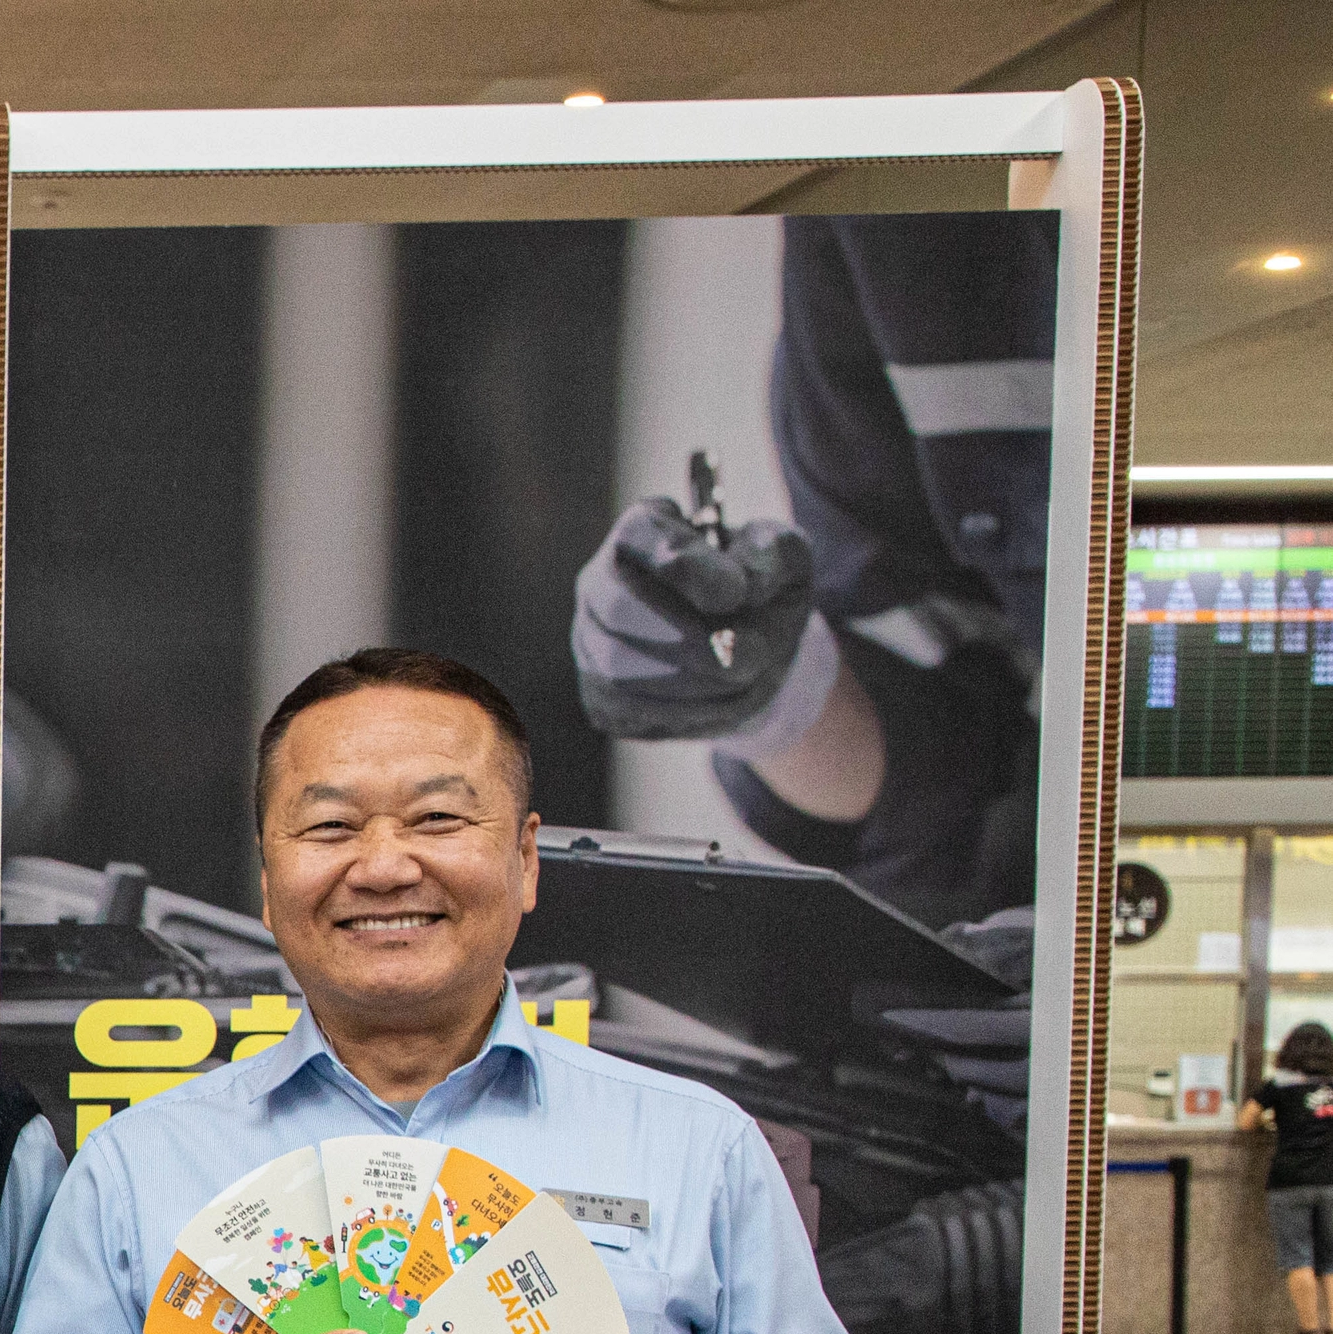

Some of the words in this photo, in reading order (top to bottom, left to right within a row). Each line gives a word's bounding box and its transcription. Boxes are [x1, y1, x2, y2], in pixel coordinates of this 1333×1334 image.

[369, 1159, 387, 1168] 무사히
[389, 1162, 414, 1170] 다녀오는
[382, 1151, 401, 1159] 어디든
[364, 1168, 398, 1179] 교통사고
[400, 1171, 417, 1182] 없는
[385, 1182, 417, 1192] 대한민국을
[487, 1193, 514, 1218] 무사히
[494, 1182, 521, 1206] 오늘도
[215, 1217, 239, 1236] 무조건
[238, 1199, 266, 1220] 안전하고
[225, 1202, 243, 1216] 누구나
[471, 1199, 508, 1229] 다녀오세
[223, 1229, 241, 1244] 행복한
[241, 1216, 259, 1231] 일상을
[258, 1208, 271, 1219] 위한
[244, 1226, 262, 1241] 캠페인
[172, 1276, 198, 1310] 오늘도
[507, 1259, 545, 1308] 오늘도
